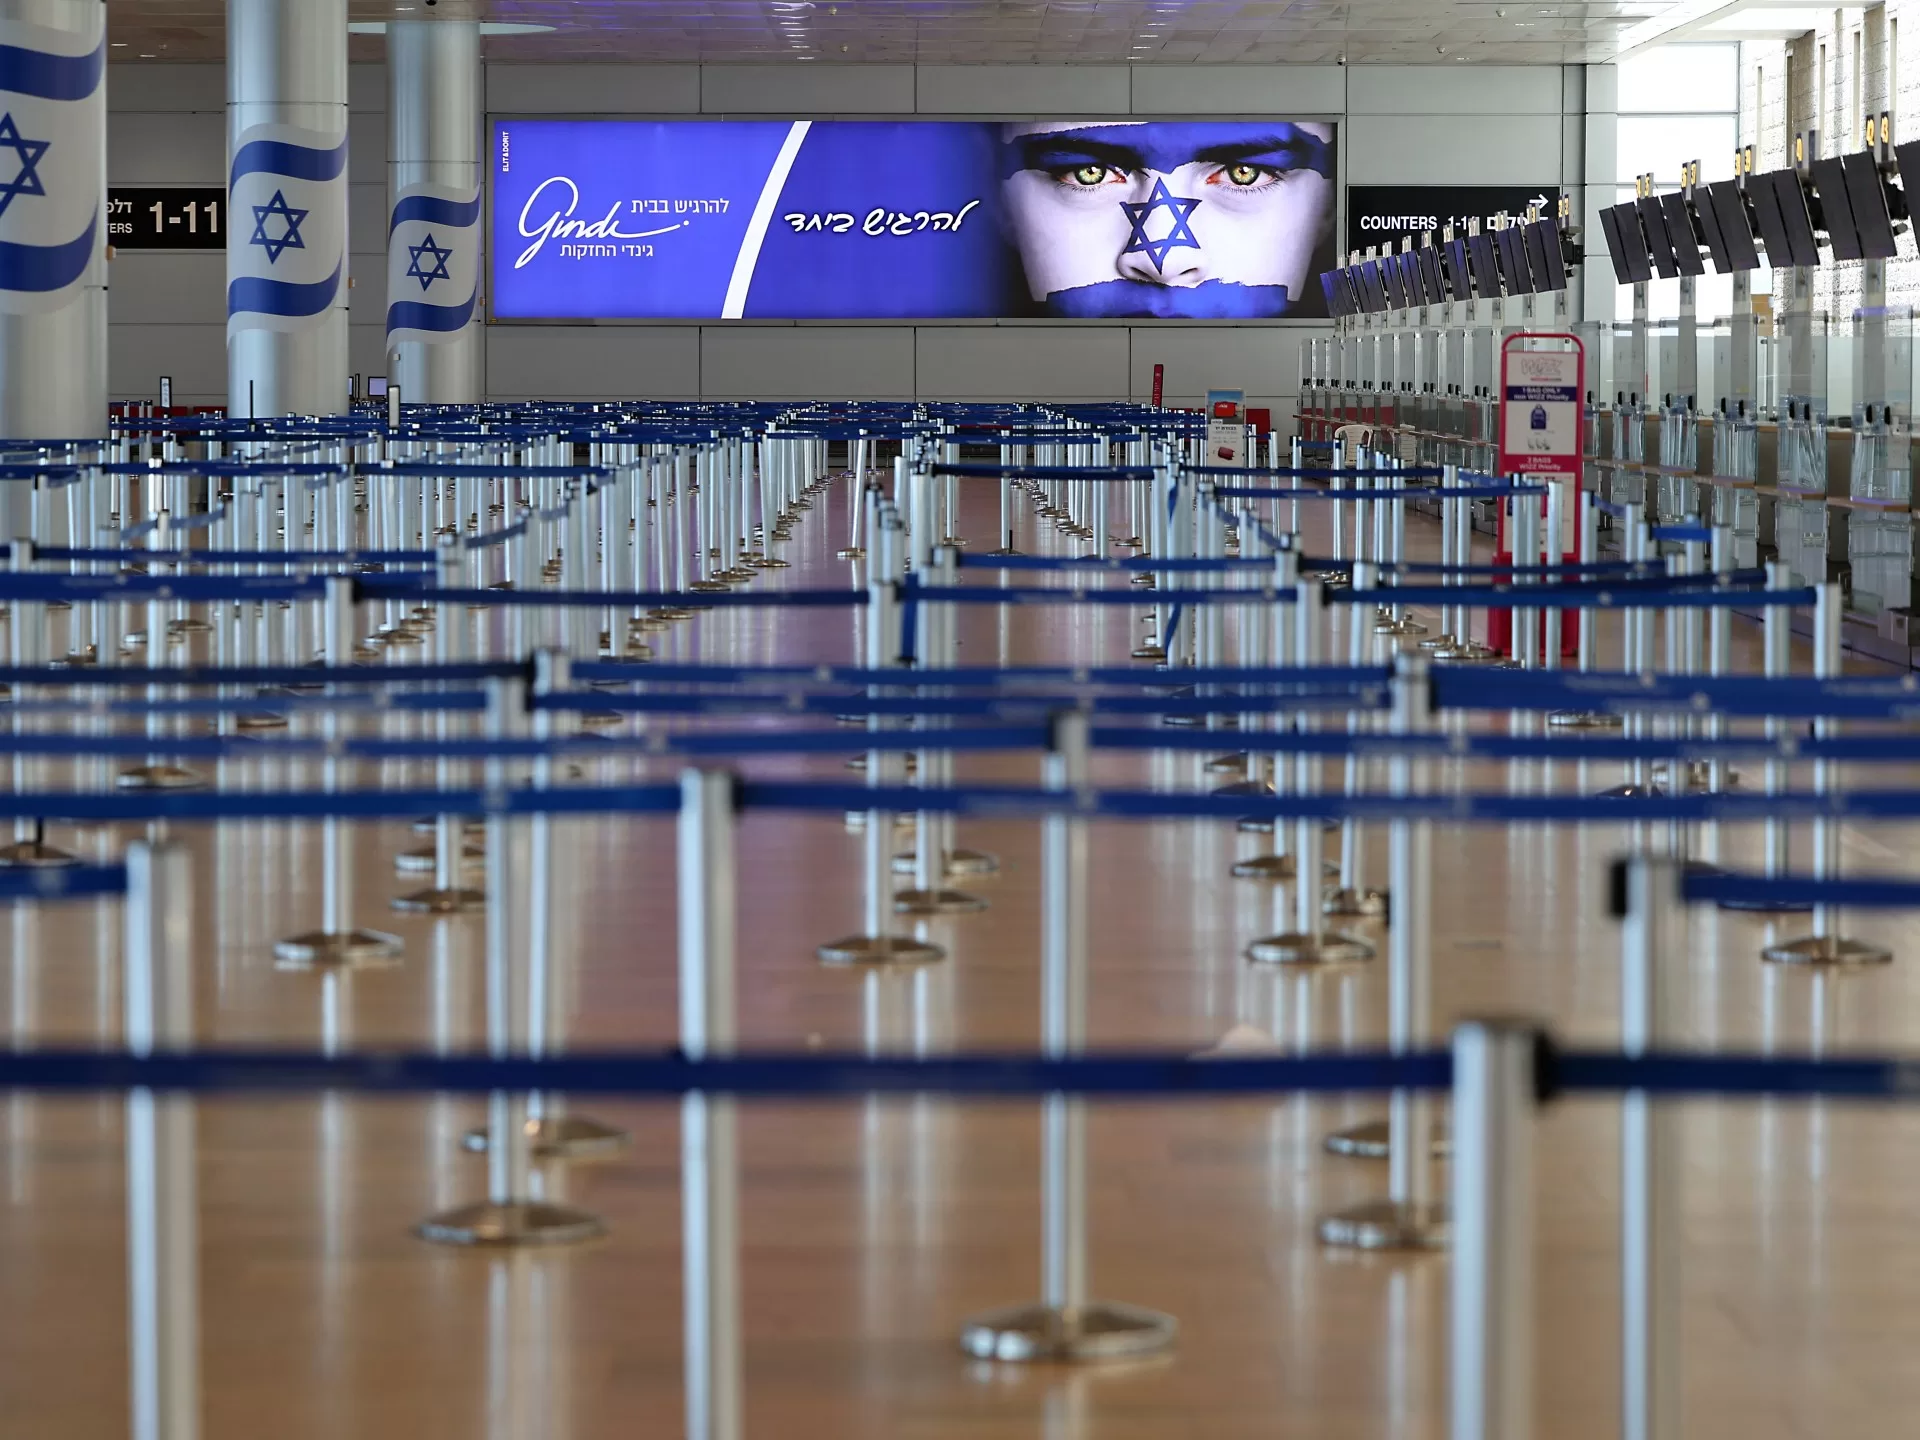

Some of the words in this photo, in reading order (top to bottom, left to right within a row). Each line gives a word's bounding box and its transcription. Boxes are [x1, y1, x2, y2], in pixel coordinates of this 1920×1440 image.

[107, 199, 133, 214] דלפ
[631, 199, 670, 214] בבית
[675, 198, 730, 214] להרגיש
[149, 201, 217, 233] 1-11
[784, 212, 855, 233] ביחד
[862, 200, 980, 236] להרגיש
[1360, 216, 1438, 230] COUNTERS
[107, 223, 133, 234] ERS
[560, 245, 617, 261] החזקות
[622, 245, 654, 257] גינדי
